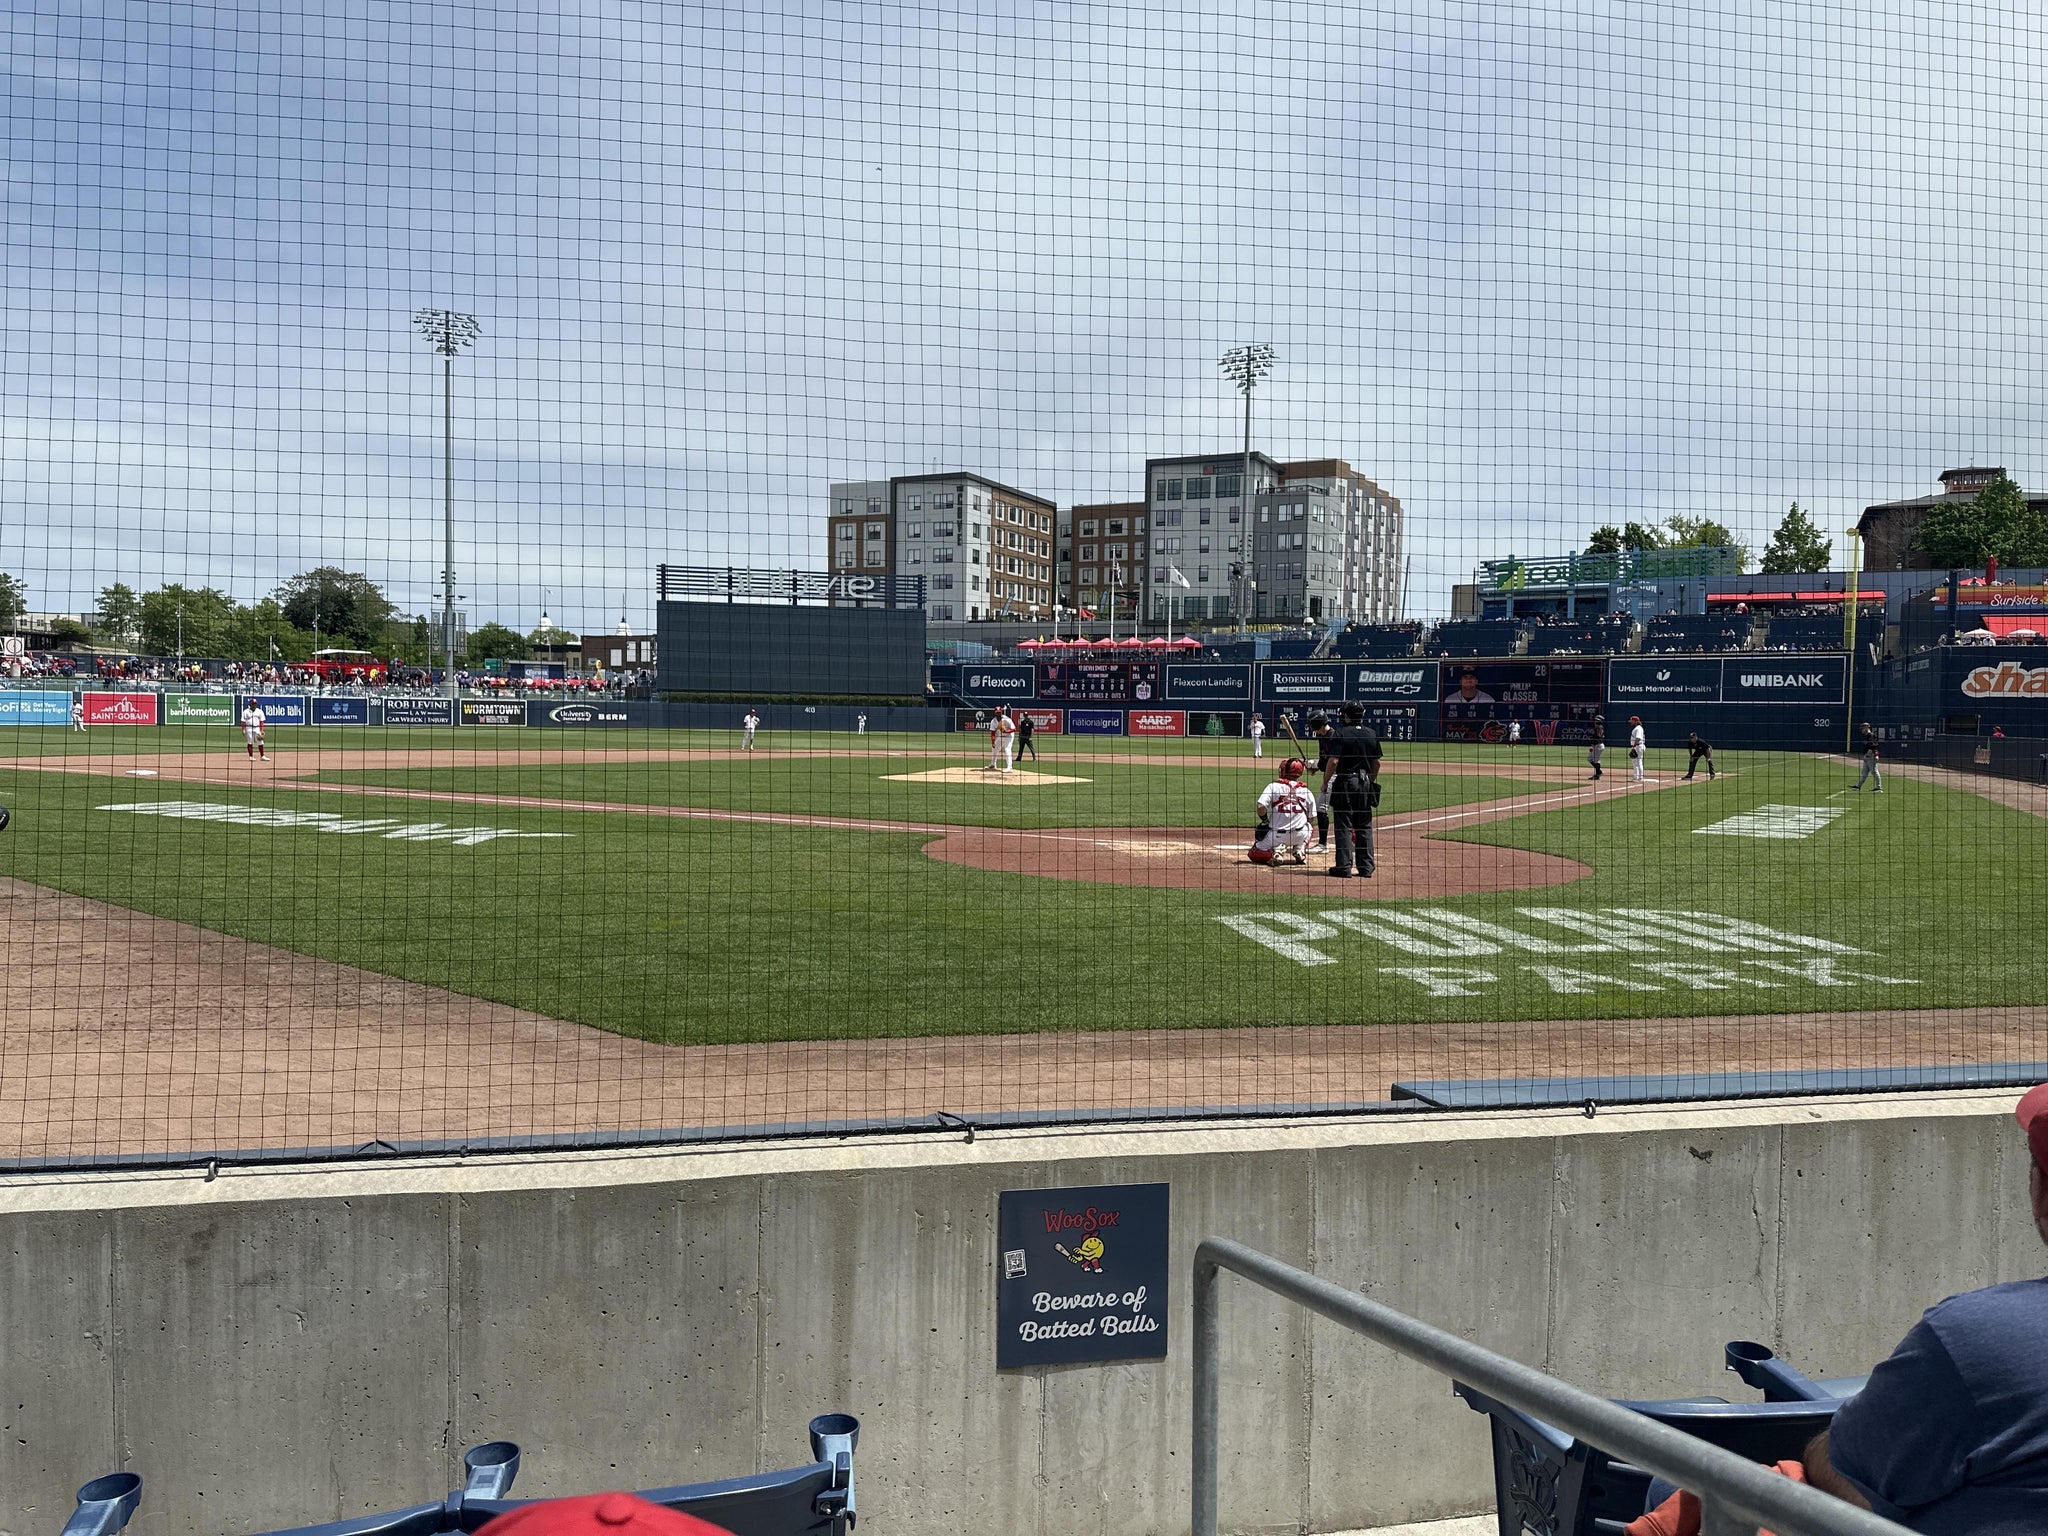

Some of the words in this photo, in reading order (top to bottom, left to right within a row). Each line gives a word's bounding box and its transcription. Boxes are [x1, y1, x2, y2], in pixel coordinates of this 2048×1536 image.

[1527, 558, 1641, 586] country
[1642, 549, 1712, 578] bank
[713, 565, 875, 599] abbvie
[1990, 593, 2039, 607] Surfside
[1173, 677, 1207, 687] Flexcon
[1208, 678, 1243, 688] Landing
[1359, 670, 1424, 683] Diamond
[1740, 674, 1824, 687] UNIBANK
[1502, 691, 1538, 701] GLASSER
[265, 705, 285, 716] Table
[287, 705, 302, 716] Talk
[387, 700, 410, 709] ROB
[412, 700, 449, 710] LEVINE
[464, 704, 521, 715] WORMTOWN
[91, 712, 149, 720] SAINT-GOBAIN
[560, 710, 592, 718] University
[1136, 715, 1173, 725] AARP
[1072, 716, 1119, 728] nationalgrid
[1814, 718, 1830, 727] 320
[1212, 907, 1885, 967] POLAR
[1377, 956, 1923, 998] PARK
[1042, 1207, 1120, 1233] WooSox
[1032, 1291, 1119, 1314] Beware
[1122, 1285, 1148, 1313] of
[1019, 1318, 1096, 1343] Batted
[1100, 1314, 1159, 1337] Balls
